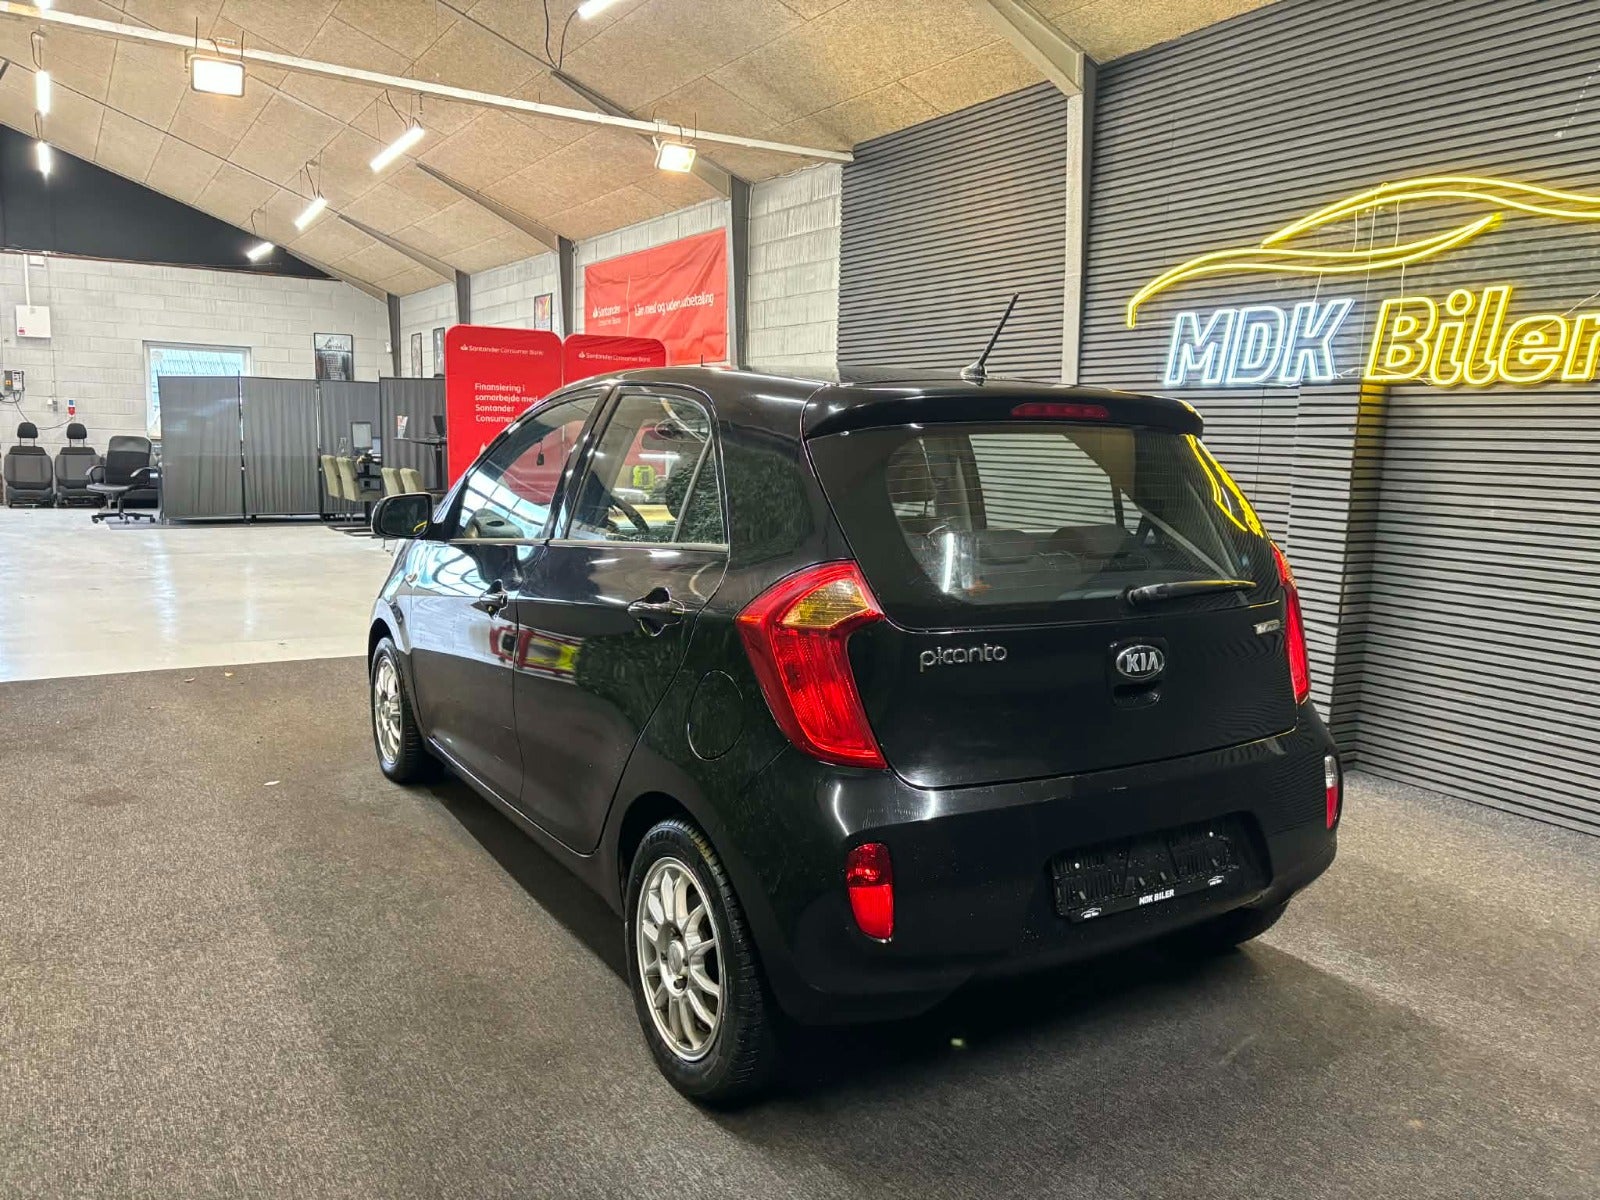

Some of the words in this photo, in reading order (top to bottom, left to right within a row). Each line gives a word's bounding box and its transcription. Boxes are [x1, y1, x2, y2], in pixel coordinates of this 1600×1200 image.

[657, 302, 666, 316] og
[1162, 298, 1355, 386] MDK
[1362, 284, 1600, 386] Biler
[468, 344, 499, 353] Santander
[500, 346, 528, 355] Consumer
[585, 352, 612, 360] Santander
[474, 382, 521, 393] Finansiering
[474, 394, 520, 403] samarbejde
[521, 395, 538, 403] med
[475, 404, 515, 412] Santander
[475, 414, 514, 423] Consumer
[919, 643, 1008, 672] picanto
[1126, 651, 1159, 673] KIA
[1154, 888, 1175, 901] BILER
